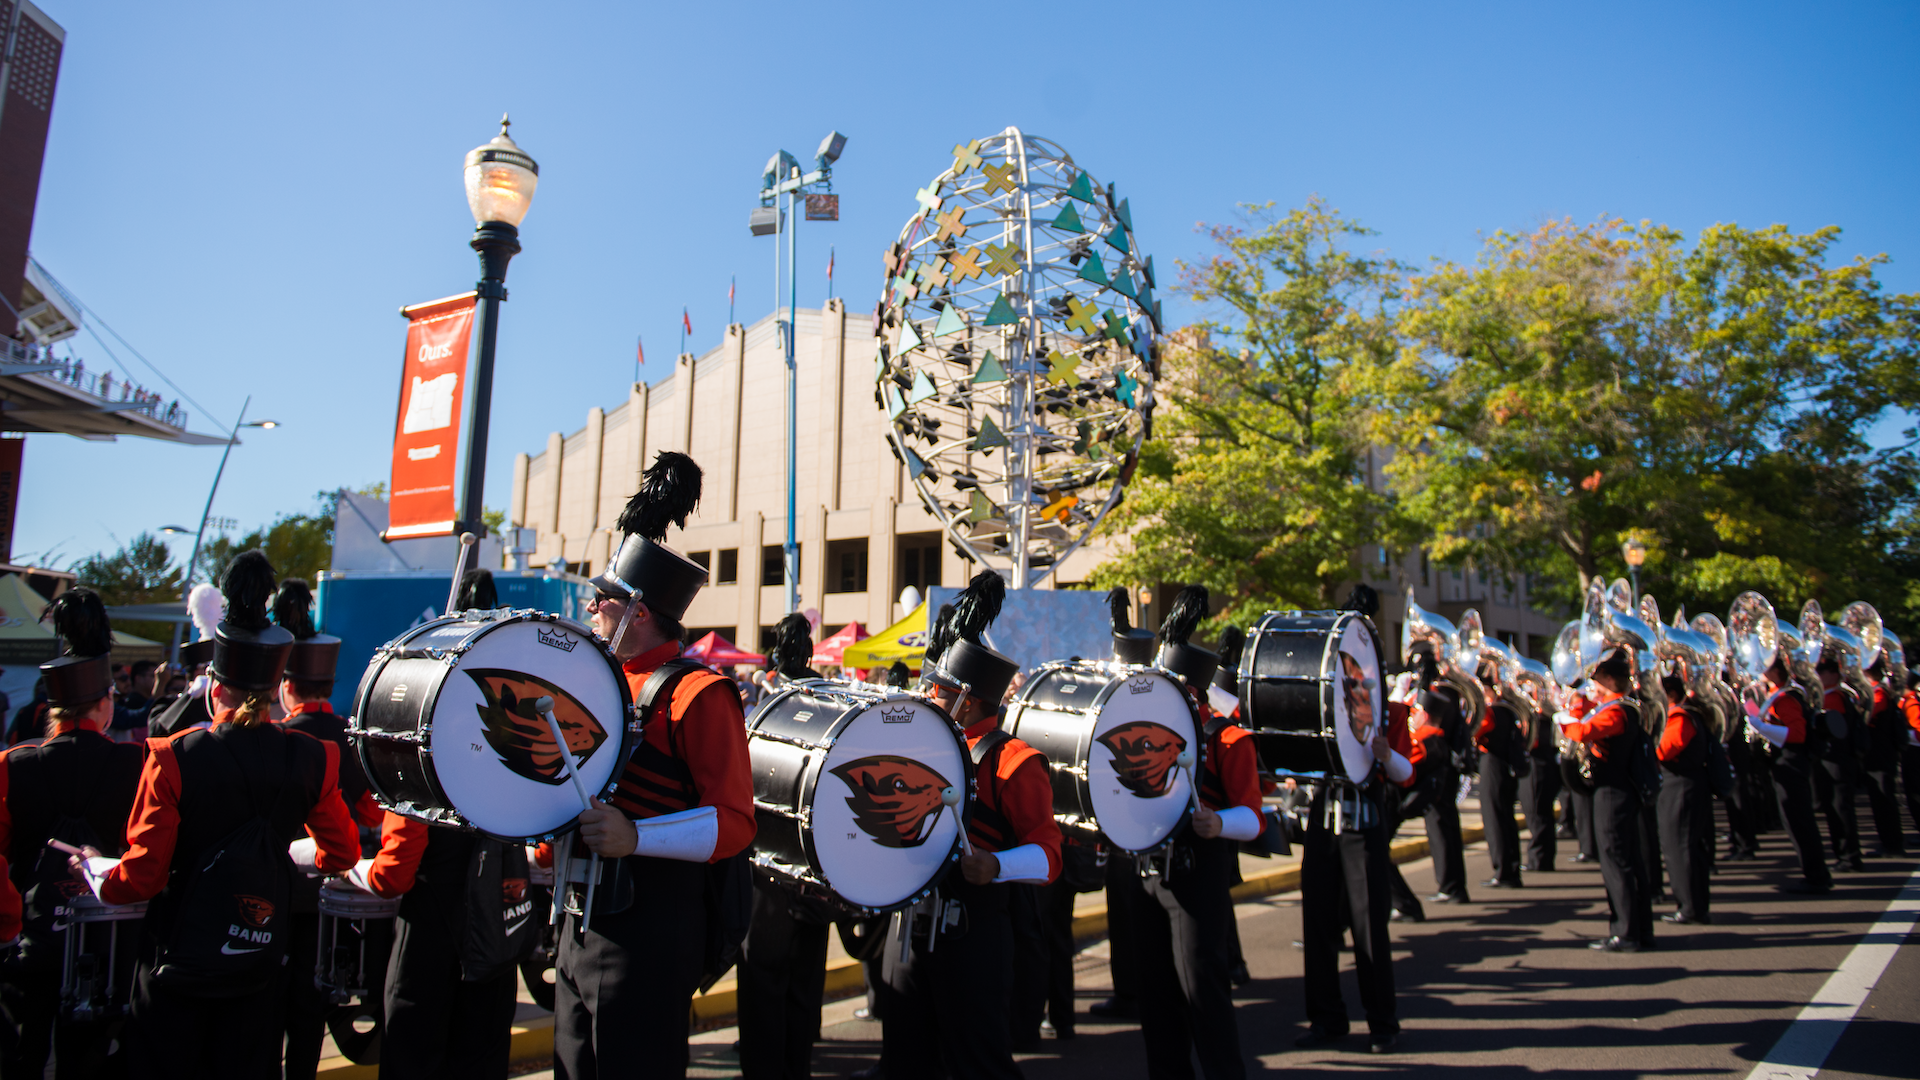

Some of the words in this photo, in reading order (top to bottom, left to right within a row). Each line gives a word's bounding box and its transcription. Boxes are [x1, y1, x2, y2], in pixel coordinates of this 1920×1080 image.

[542, 635, 570, 650] REMO
[470, 742, 482, 752] TM
[228, 923, 272, 944] BAND
